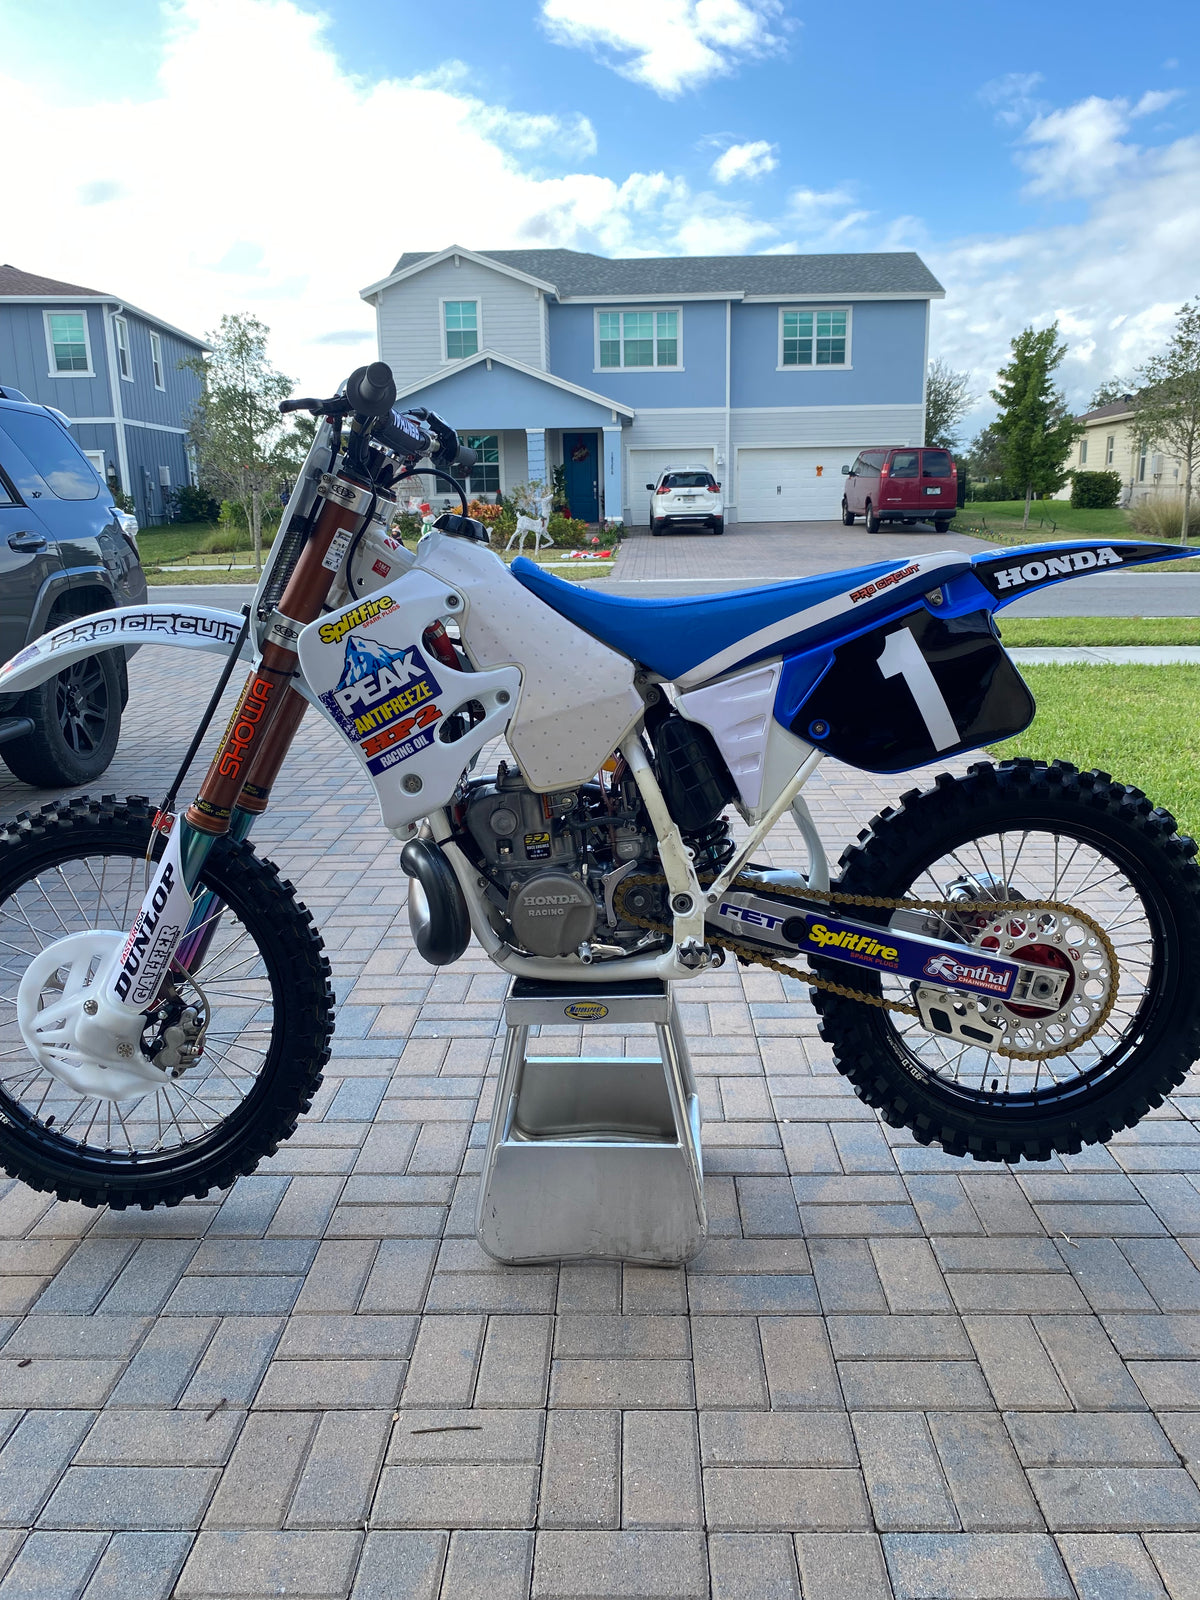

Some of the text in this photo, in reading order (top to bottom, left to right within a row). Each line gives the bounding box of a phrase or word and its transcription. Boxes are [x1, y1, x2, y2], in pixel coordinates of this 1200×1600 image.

[849, 563, 920, 603] PRO CIRCUIT
[994, 547, 1123, 589] HONDA
[50, 613, 243, 652] PRO CIRCUIT
[318, 596, 395, 644] SplitFire
[362, 604, 401, 629] SPARK PLUGS
[333, 650, 427, 717] PEAK
[876, 627, 961, 752] 1
[353, 680, 434, 736] ANTIFREEZE
[218, 677, 274, 780] SHOWA
[360, 704, 443, 758] HP2
[380, 734, 430, 768] RACING OIL
[523, 894, 582, 906] HONDA
[528, 908, 565, 917] RACING
[113, 862, 175, 1003] DUNLOP
[808, 923, 898, 962] SplitFire
[132, 925, 180, 1004] GALFER
[850, 952, 899, 969] SPARK PLUGS
[925, 954, 1011, 987] Renthal
[957, 976, 1008, 993] CHAINWHEELS
